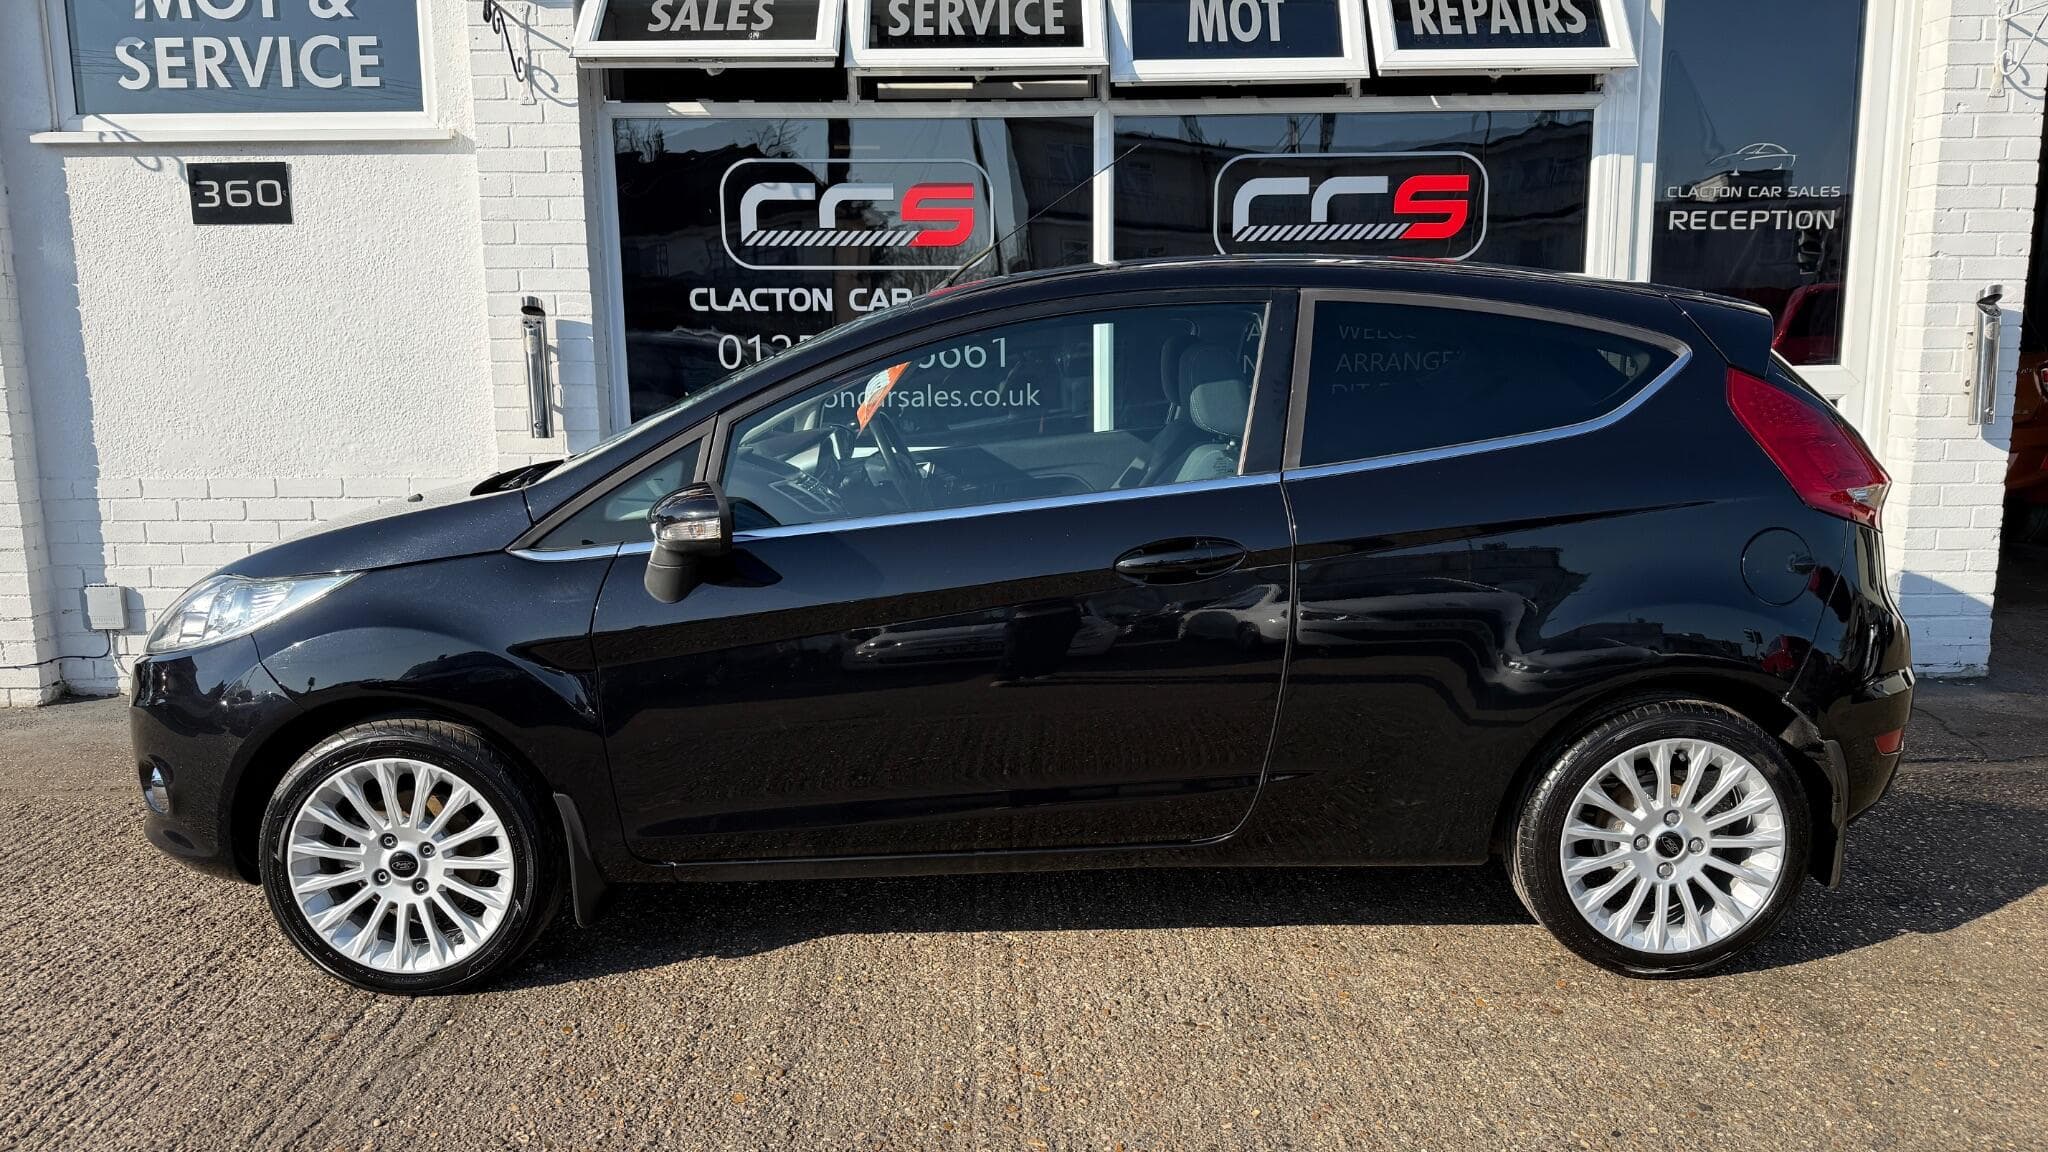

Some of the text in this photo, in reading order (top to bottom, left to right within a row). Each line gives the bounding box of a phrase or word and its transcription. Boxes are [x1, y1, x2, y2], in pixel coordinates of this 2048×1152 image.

[647, 0, 775, 32] SALES
[888, 0, 1065, 36] SERVICE
[1188, 0, 1284, 43] MOT
[1410, 0, 1588, 35] REPAIRS
[115, 35, 381, 90] SERVICE
[196, 180, 283, 207] 360
[1667, 186, 1841, 198] CLACTON CAR SALES
[1668, 210, 1836, 231] RECEPTION
[689, 287, 833, 312] CLACTON
[918, 337, 1006, 369] 661
[824, 382, 1041, 408] onrsales.co.uk
